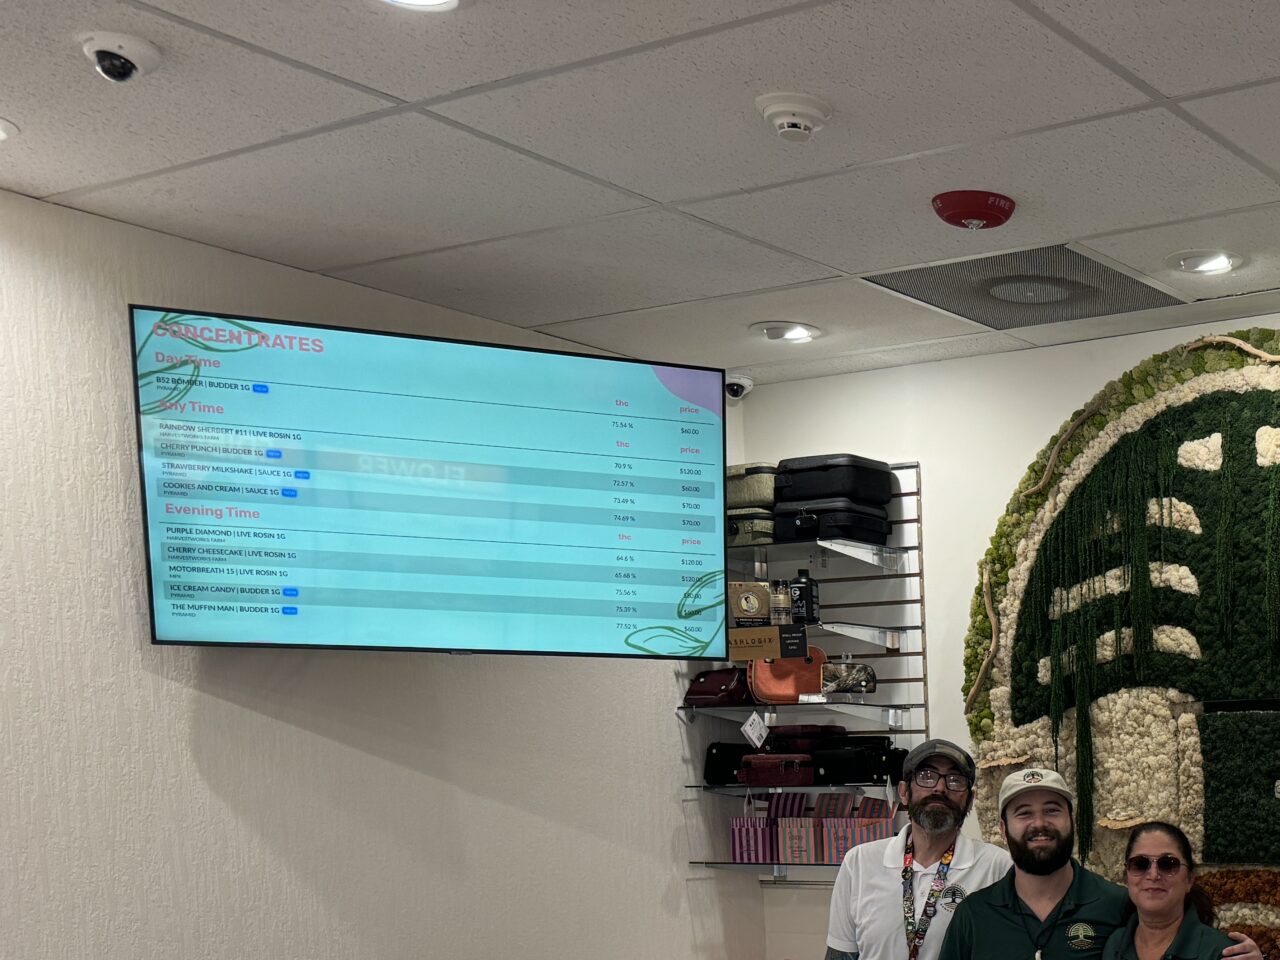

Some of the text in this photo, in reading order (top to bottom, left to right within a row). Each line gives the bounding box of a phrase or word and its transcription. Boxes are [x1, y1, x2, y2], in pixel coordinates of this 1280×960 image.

[988, 197, 1010, 209] FIRE
[153, 322, 325, 352] CONCENTRATES
[155, 352, 221, 368] Day Time
[156, 376, 170, 384] B52
[171, 377, 204, 387] BOMBER
[209, 380, 238, 390] BUDDER
[160, 400, 224, 414] Any Time
[615, 399, 629, 407] thc
[679, 406, 700, 414] price
[159, 423, 196, 432] RAINBOW
[197, 426, 233, 434] SHERBERT
[160, 443, 190, 451] CHERRY
[191, 445, 217, 453] PUNCH
[222, 447, 252, 455] BUDDER
[680, 447, 700, 455] price
[162, 462, 210, 472] STRAWBERRY
[212, 466, 253, 475] MILKSHAKE
[258, 469, 281, 477] SAUCE
[163, 482, 195, 490] COOKIES
[197, 484, 213, 492] AND
[214, 485, 240, 493] CREAM
[245, 487, 268, 495] SAUCE
[165, 503, 261, 519] Evening Time
[166, 527, 194, 535] PURPLE
[195, 529, 232, 537] DIAMOND
[253, 532, 275, 540] ROSIN
[167, 546, 197, 554] CHERRY
[197, 548, 243, 556] CHEESECAKE
[264, 551, 286, 559] ROSIN
[169, 566, 225, 575] MOTORBREATH
[183, 585, 209, 593] CREAM
[210, 586, 235, 594] CANDY
[240, 587, 270, 595] BUDDER
[171, 603, 185, 611] THE
[187, 604, 216, 612] MUFFIN
